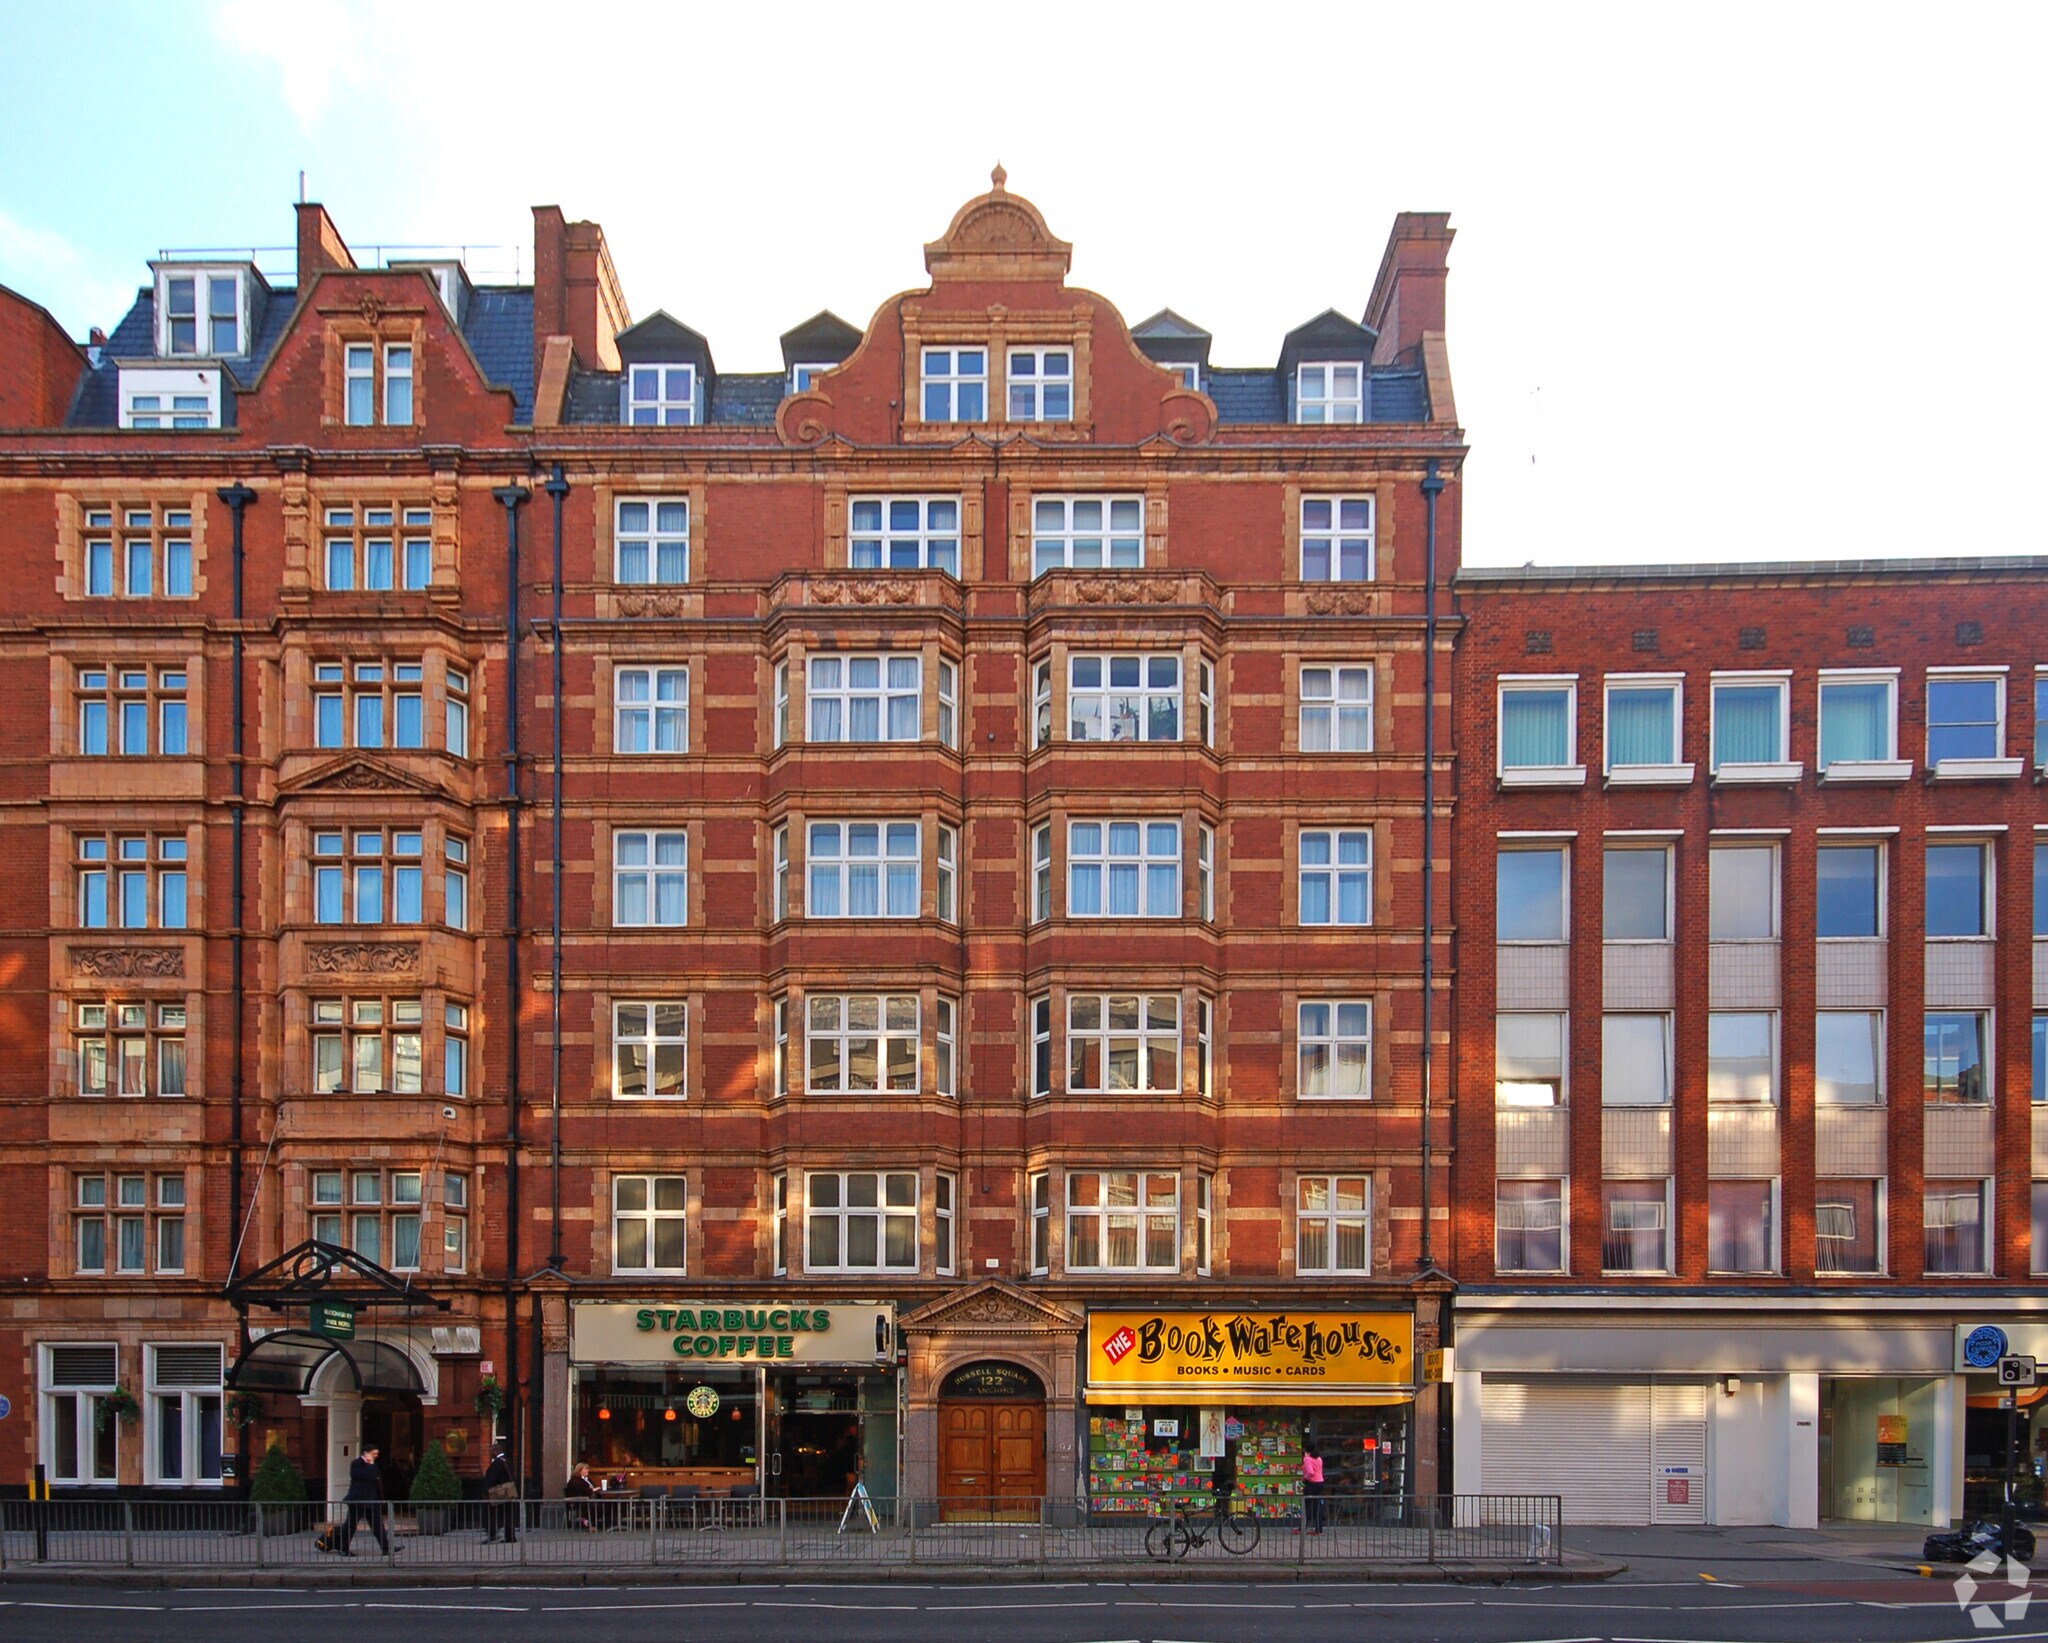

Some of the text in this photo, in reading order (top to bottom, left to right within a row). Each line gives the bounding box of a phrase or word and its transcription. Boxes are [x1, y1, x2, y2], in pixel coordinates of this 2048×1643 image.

[636, 1309, 830, 1331] STARBUCKS
[672, 1335, 794, 1357] COFFEE
[1105, 1331, 1131, 1359] THE
[954, 1368, 1030, 1385] RUSSELL SQUARE
[1177, 1366, 1326, 1376] BOOKS MUSIC CARDS
[981, 1376, 1003, 1386] 122
